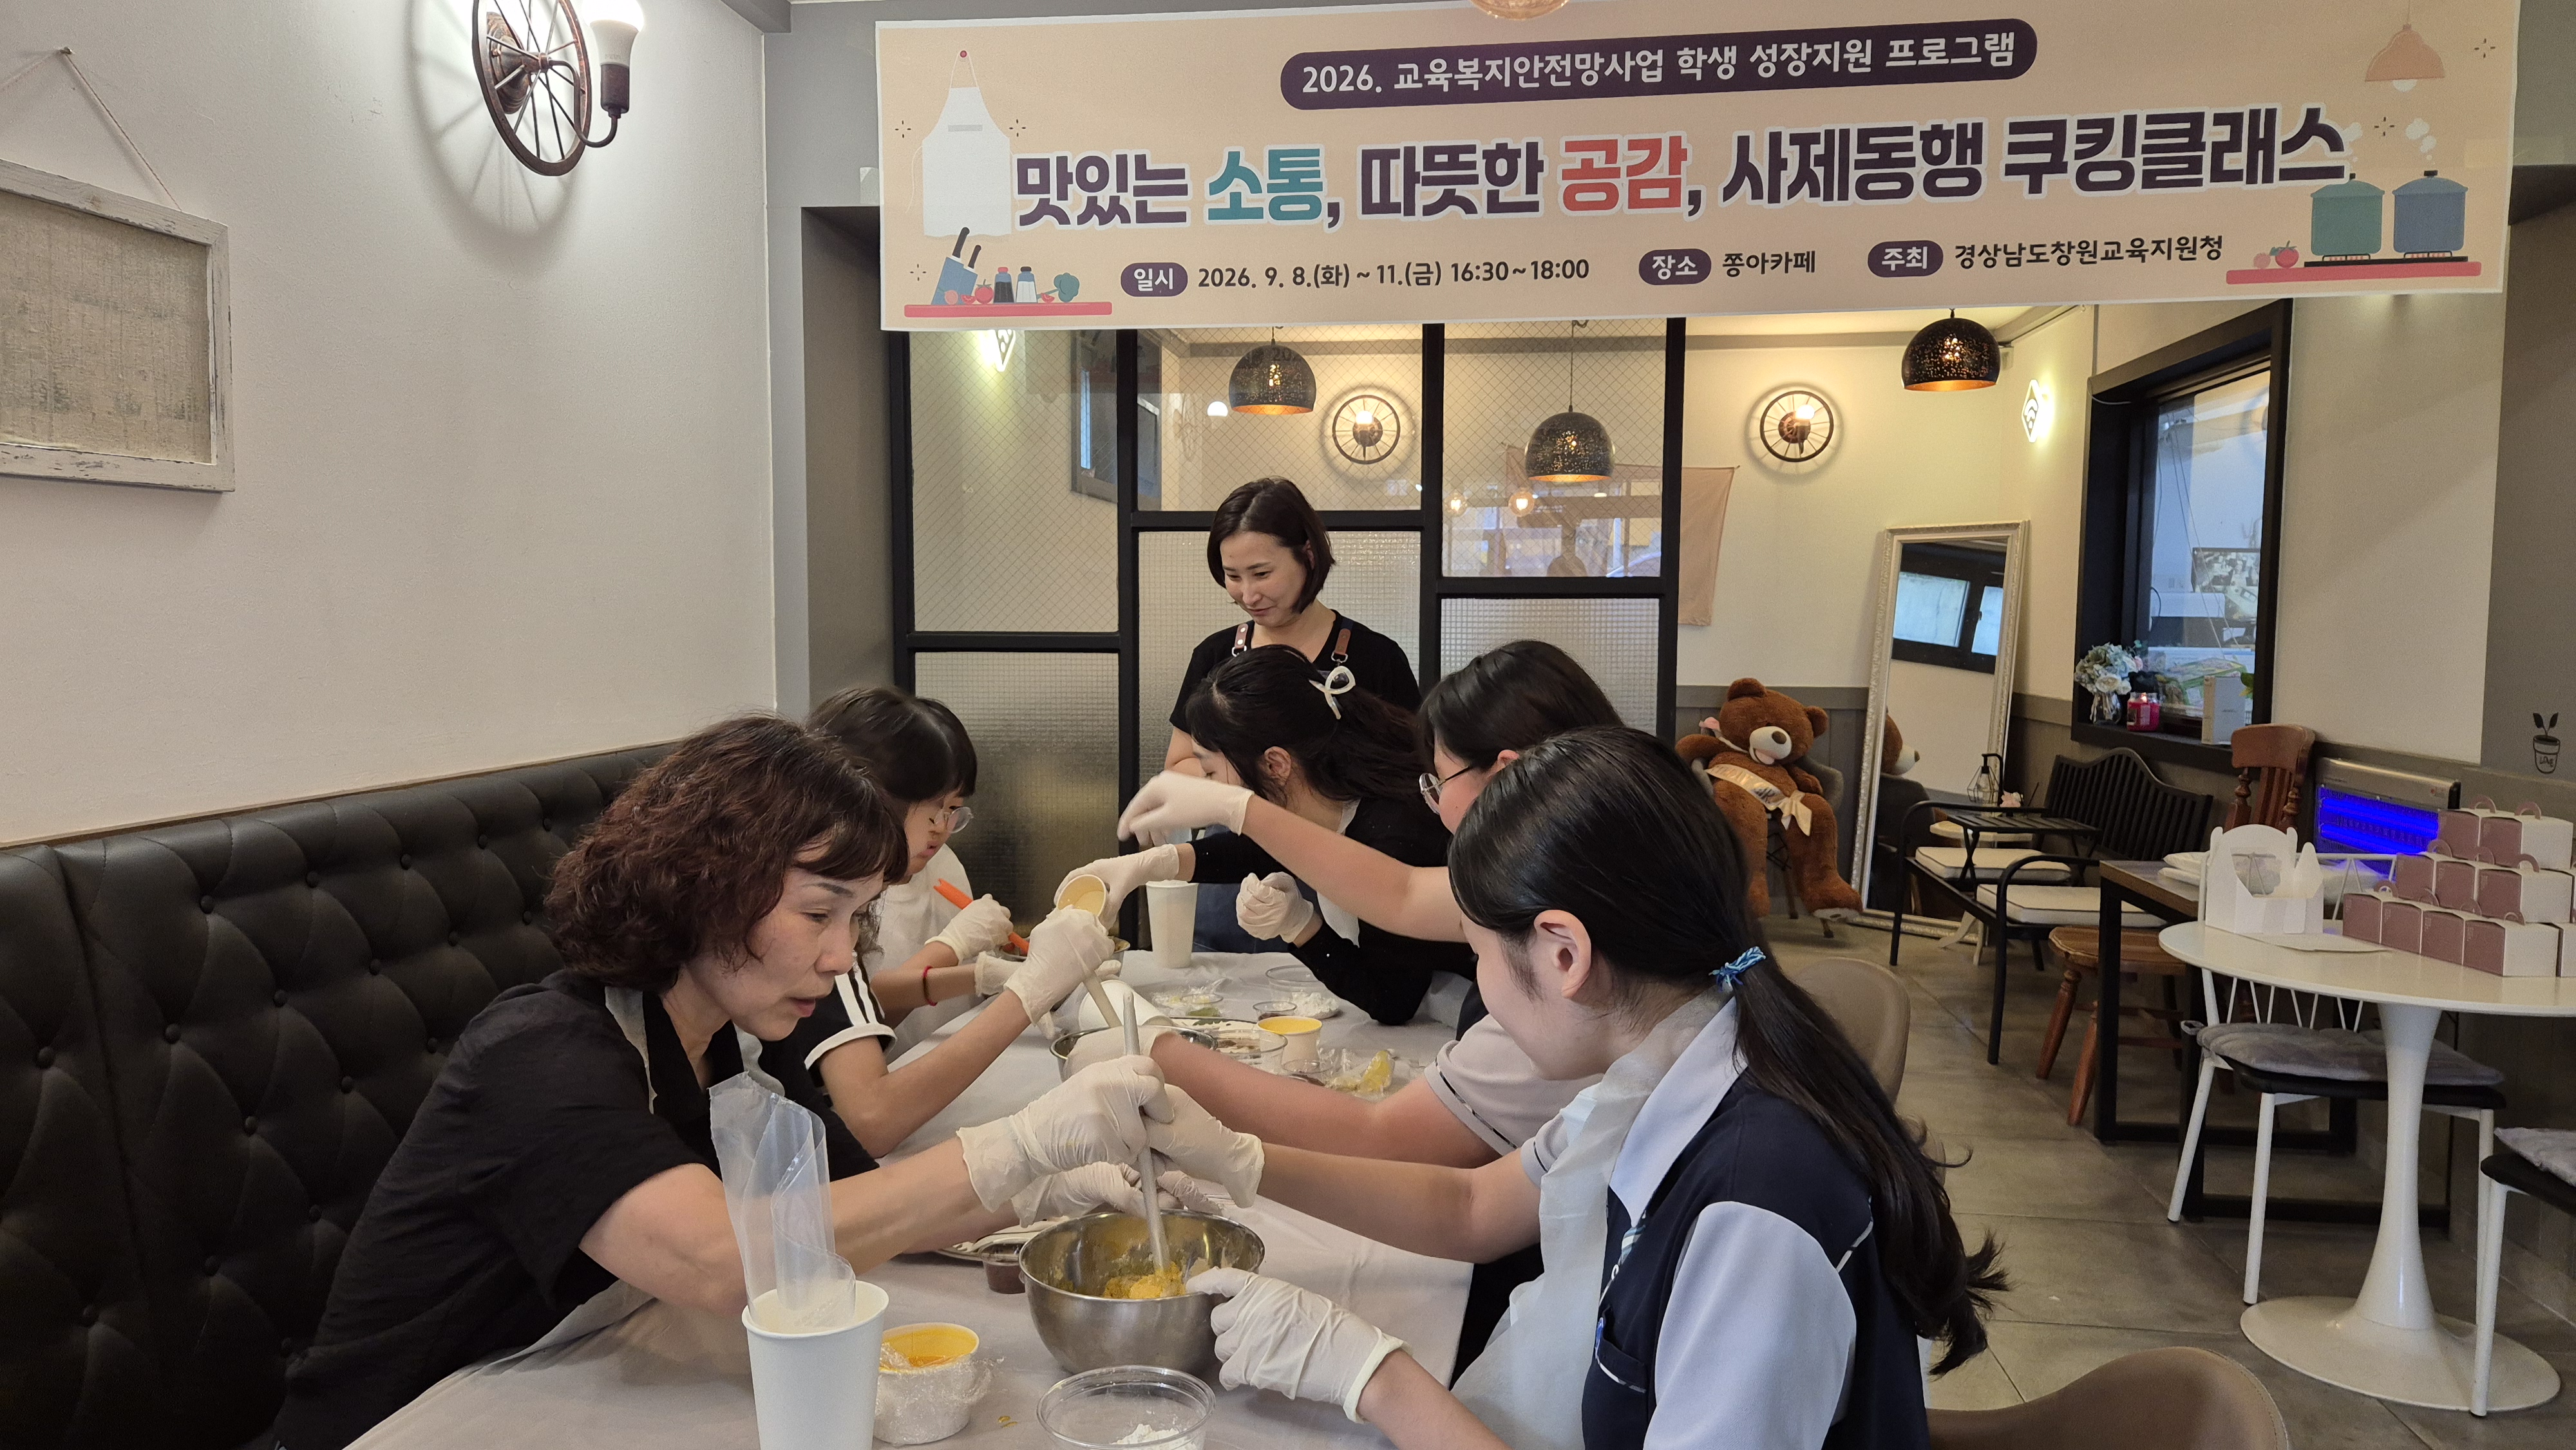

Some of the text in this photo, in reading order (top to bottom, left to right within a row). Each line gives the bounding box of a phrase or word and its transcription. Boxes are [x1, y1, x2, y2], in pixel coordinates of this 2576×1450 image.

[1302, 32, 2015, 93] 2026. 교육복지안전망사업 학생 성장지원 프로그램
[1016, 107, 2346, 229] 맛있는 소통, 따뜻한 공감, 사제동행 쿠킹클래스
[1651, 250, 1816, 280] 장소 쫑아카페
[1881, 234, 2223, 272] 주최 경상남도창원교육지원청
[1133, 267, 1174, 292] 일시
[1198, 267, 1256, 288] 2026.
[1264, 267, 1285, 288] 9.
[1450, 258, 1590, 283] 16:30~18:00
